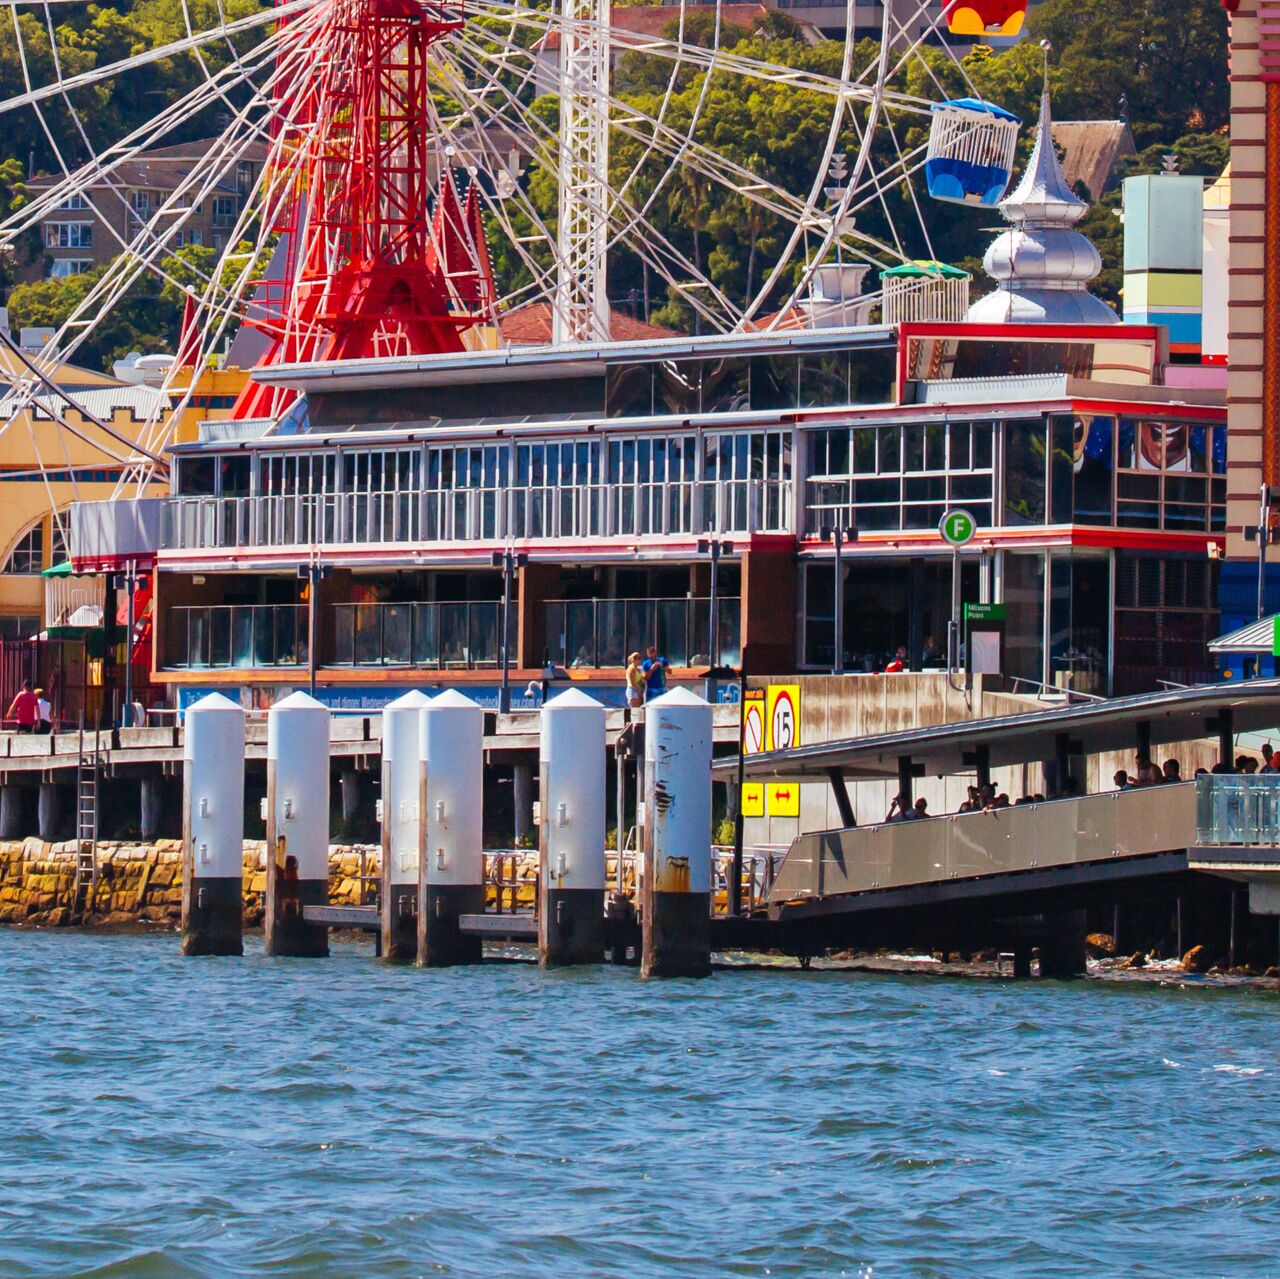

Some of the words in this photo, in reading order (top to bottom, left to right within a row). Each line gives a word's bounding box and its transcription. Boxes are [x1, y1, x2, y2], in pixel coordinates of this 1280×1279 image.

[953, 518, 965, 538] F
[968, 604, 991, 612] Milsons
[776, 711, 791, 749] 15
